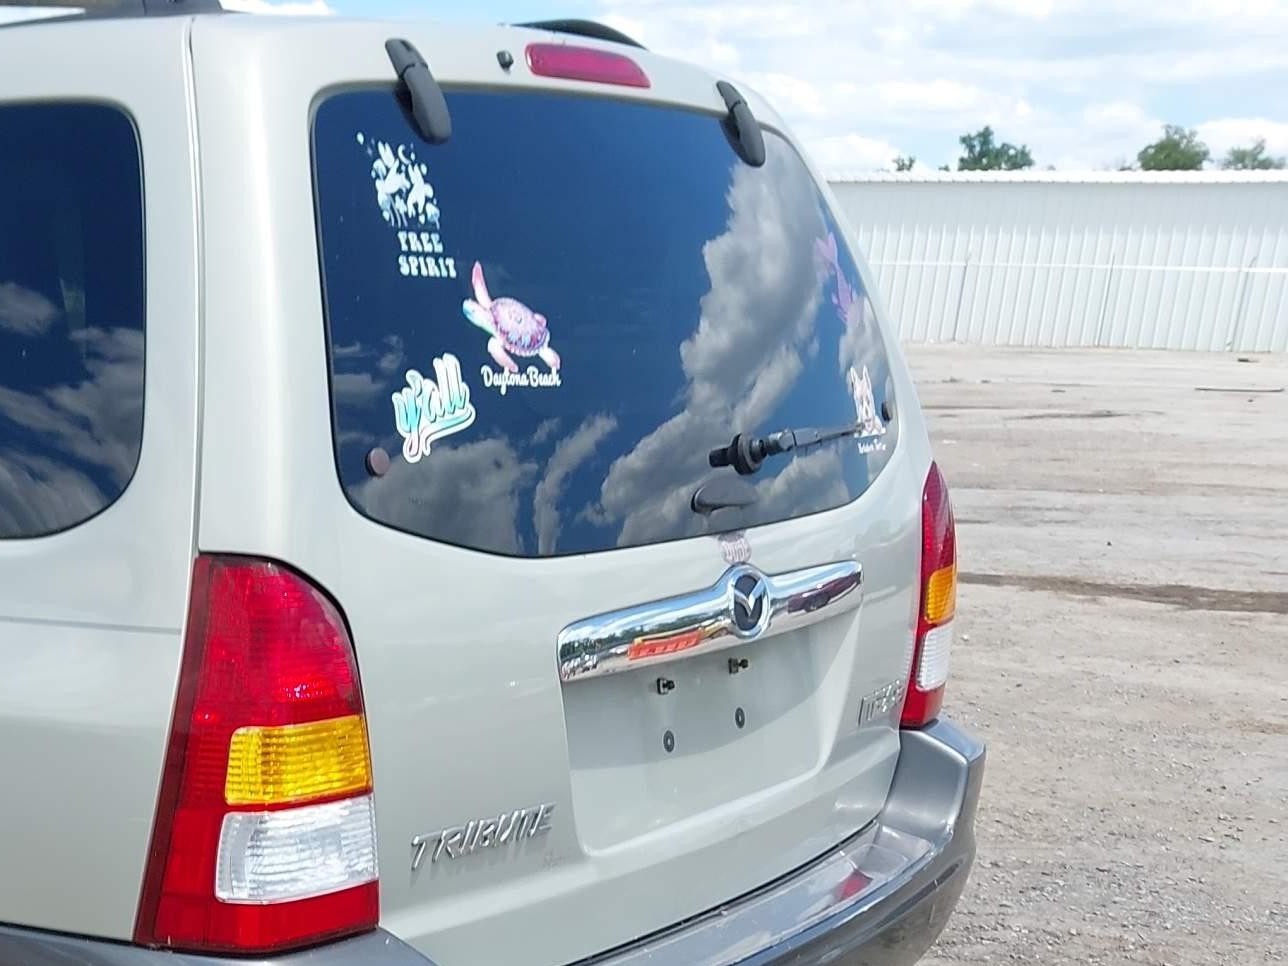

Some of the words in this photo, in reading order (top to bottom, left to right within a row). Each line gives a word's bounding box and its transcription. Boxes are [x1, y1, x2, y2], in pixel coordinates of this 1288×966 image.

[397, 231, 443, 253] FREE
[398, 255, 457, 278] SPIRIT
[481, 365, 529, 395] Daytona
[527, 365, 562, 387] Beach
[411, 802, 556, 870] TRIBUTE
